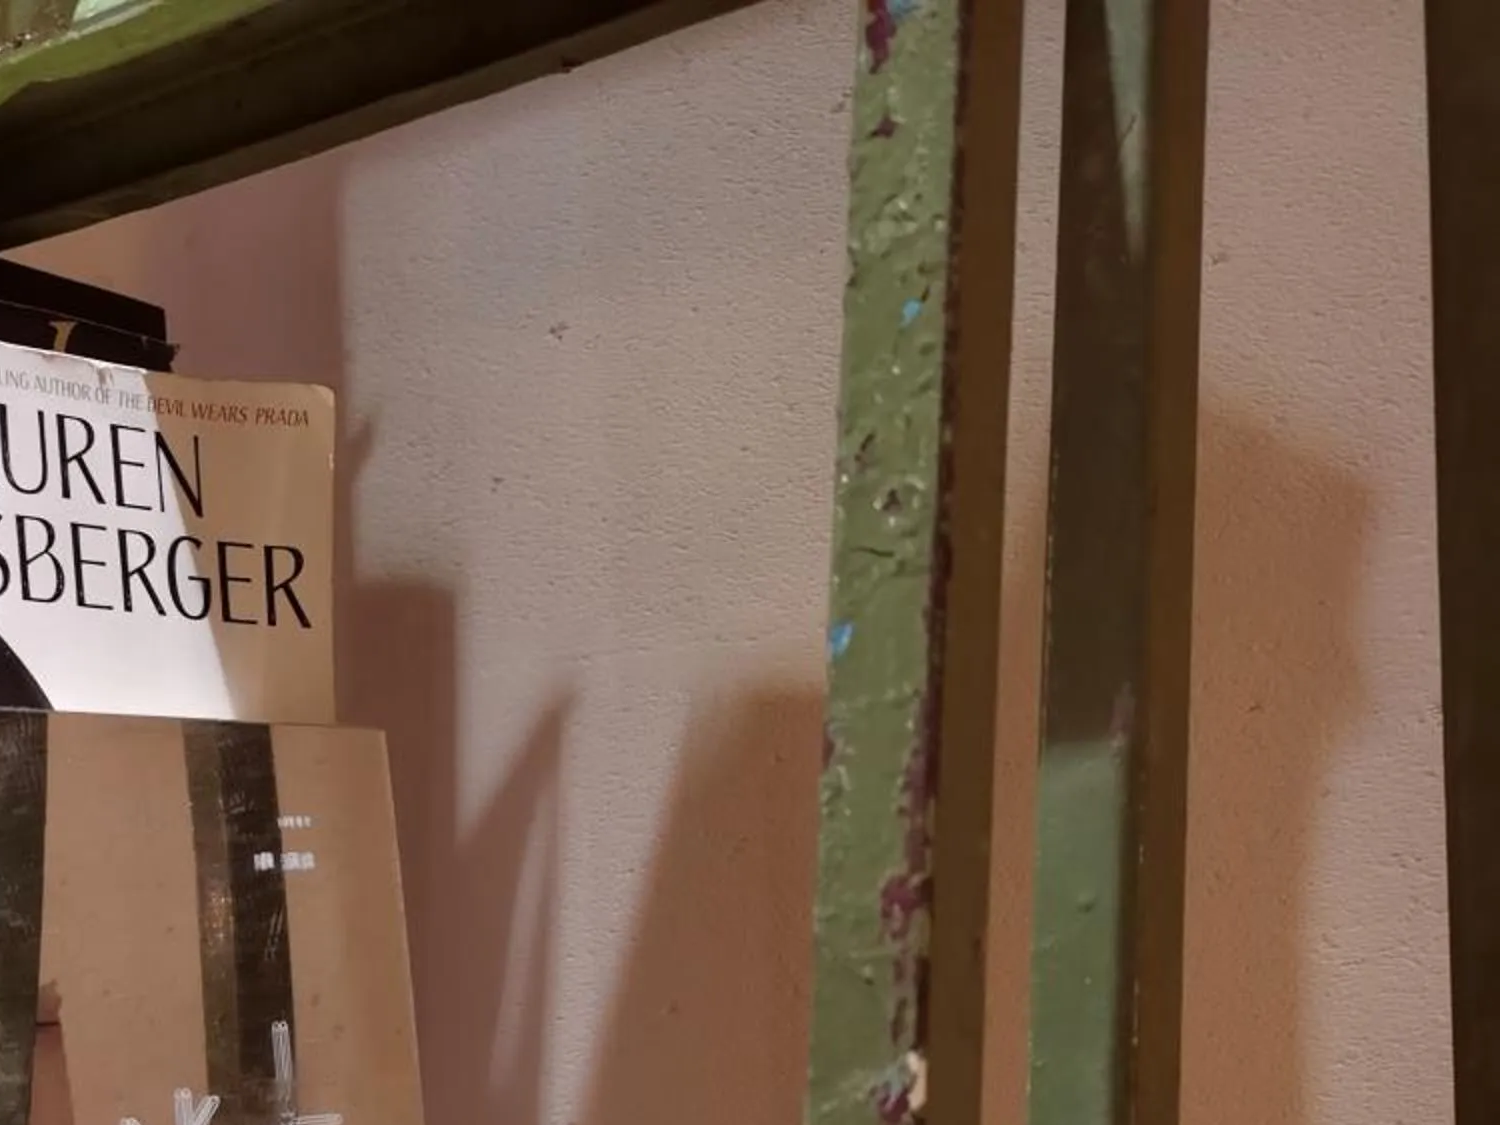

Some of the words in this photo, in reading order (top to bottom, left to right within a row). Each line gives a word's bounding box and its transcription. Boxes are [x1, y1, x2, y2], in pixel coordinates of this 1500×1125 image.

[33, 373, 91, 401] AUTHOR
[118, 390, 148, 413] THE
[148, 396, 184, 418] DEVIL
[188, 402, 249, 425] WEARS
[254, 406, 310, 428] PRADA
